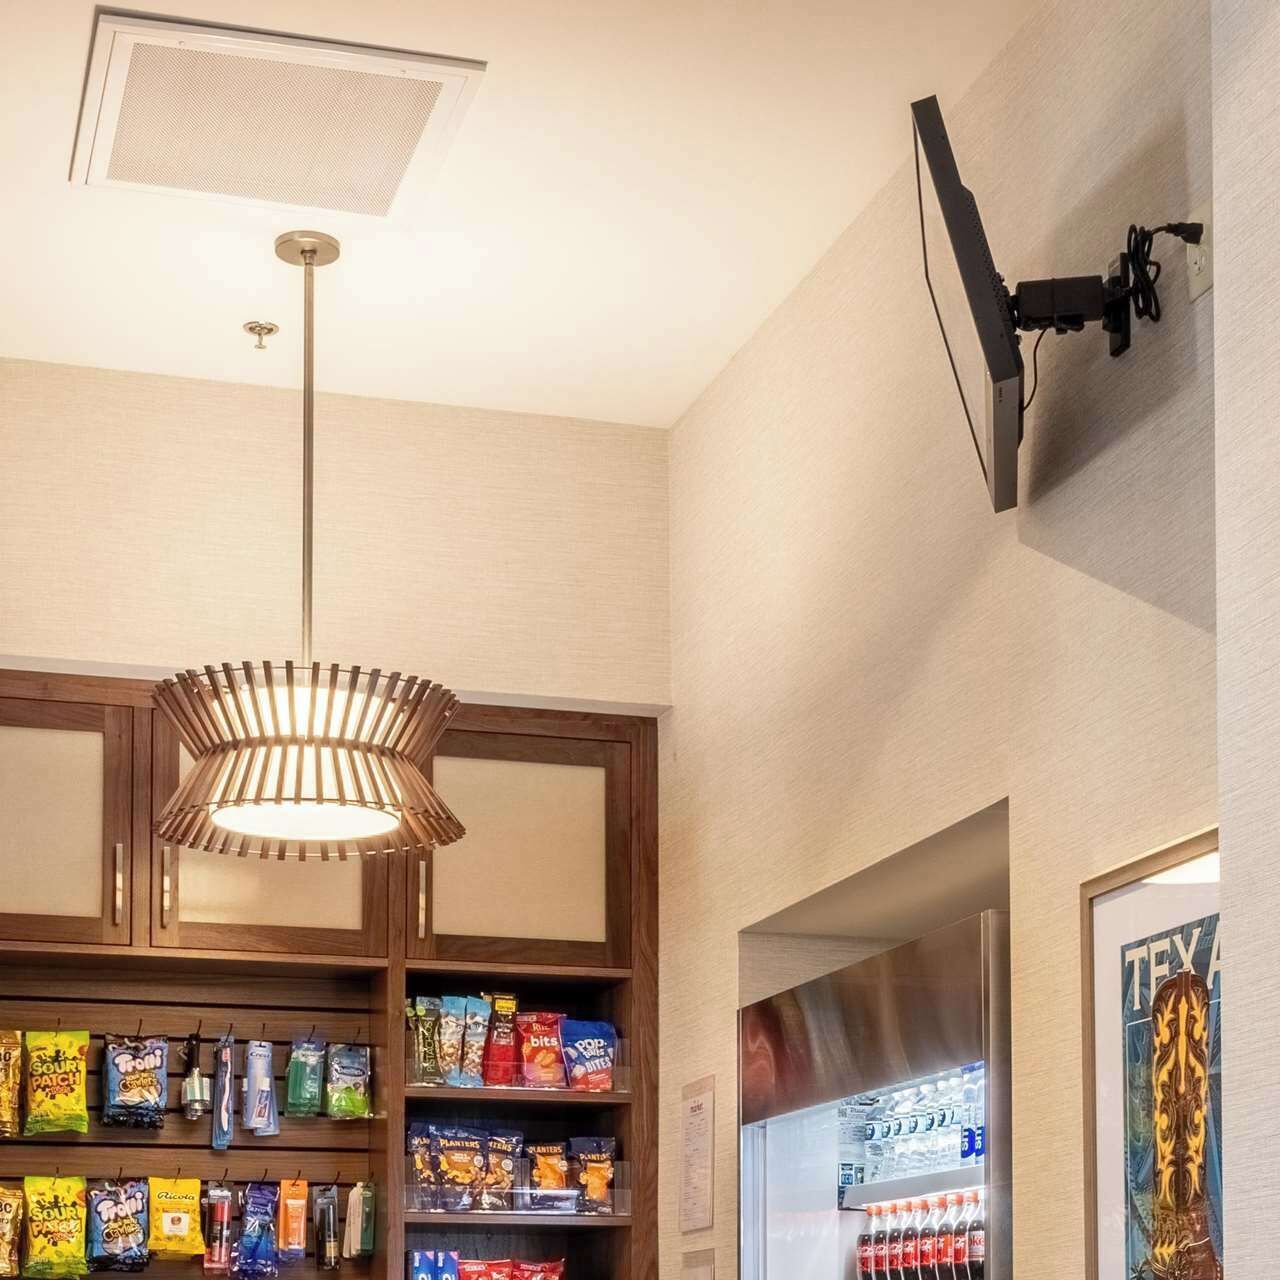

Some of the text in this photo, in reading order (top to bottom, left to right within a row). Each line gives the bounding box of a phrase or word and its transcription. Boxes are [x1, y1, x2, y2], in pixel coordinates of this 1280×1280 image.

[1124, 920, 1220, 1011] TEXA
[426, 1021, 436, 1073] PISTACHIOS
[530, 1035, 558, 1048] bits
[115, 1049, 162, 1074] Trolli
[249, 1051, 270, 1059] Crest
[32, 1060, 77, 1075] SOUR
[585, 1057, 612, 1073] BITES
[31, 1072, 81, 1092] PATCH
[439, 1139, 481, 1150] PLANTERS
[156, 1191, 196, 1202] Ricola
[31, 1206, 78, 1221] SOUR
